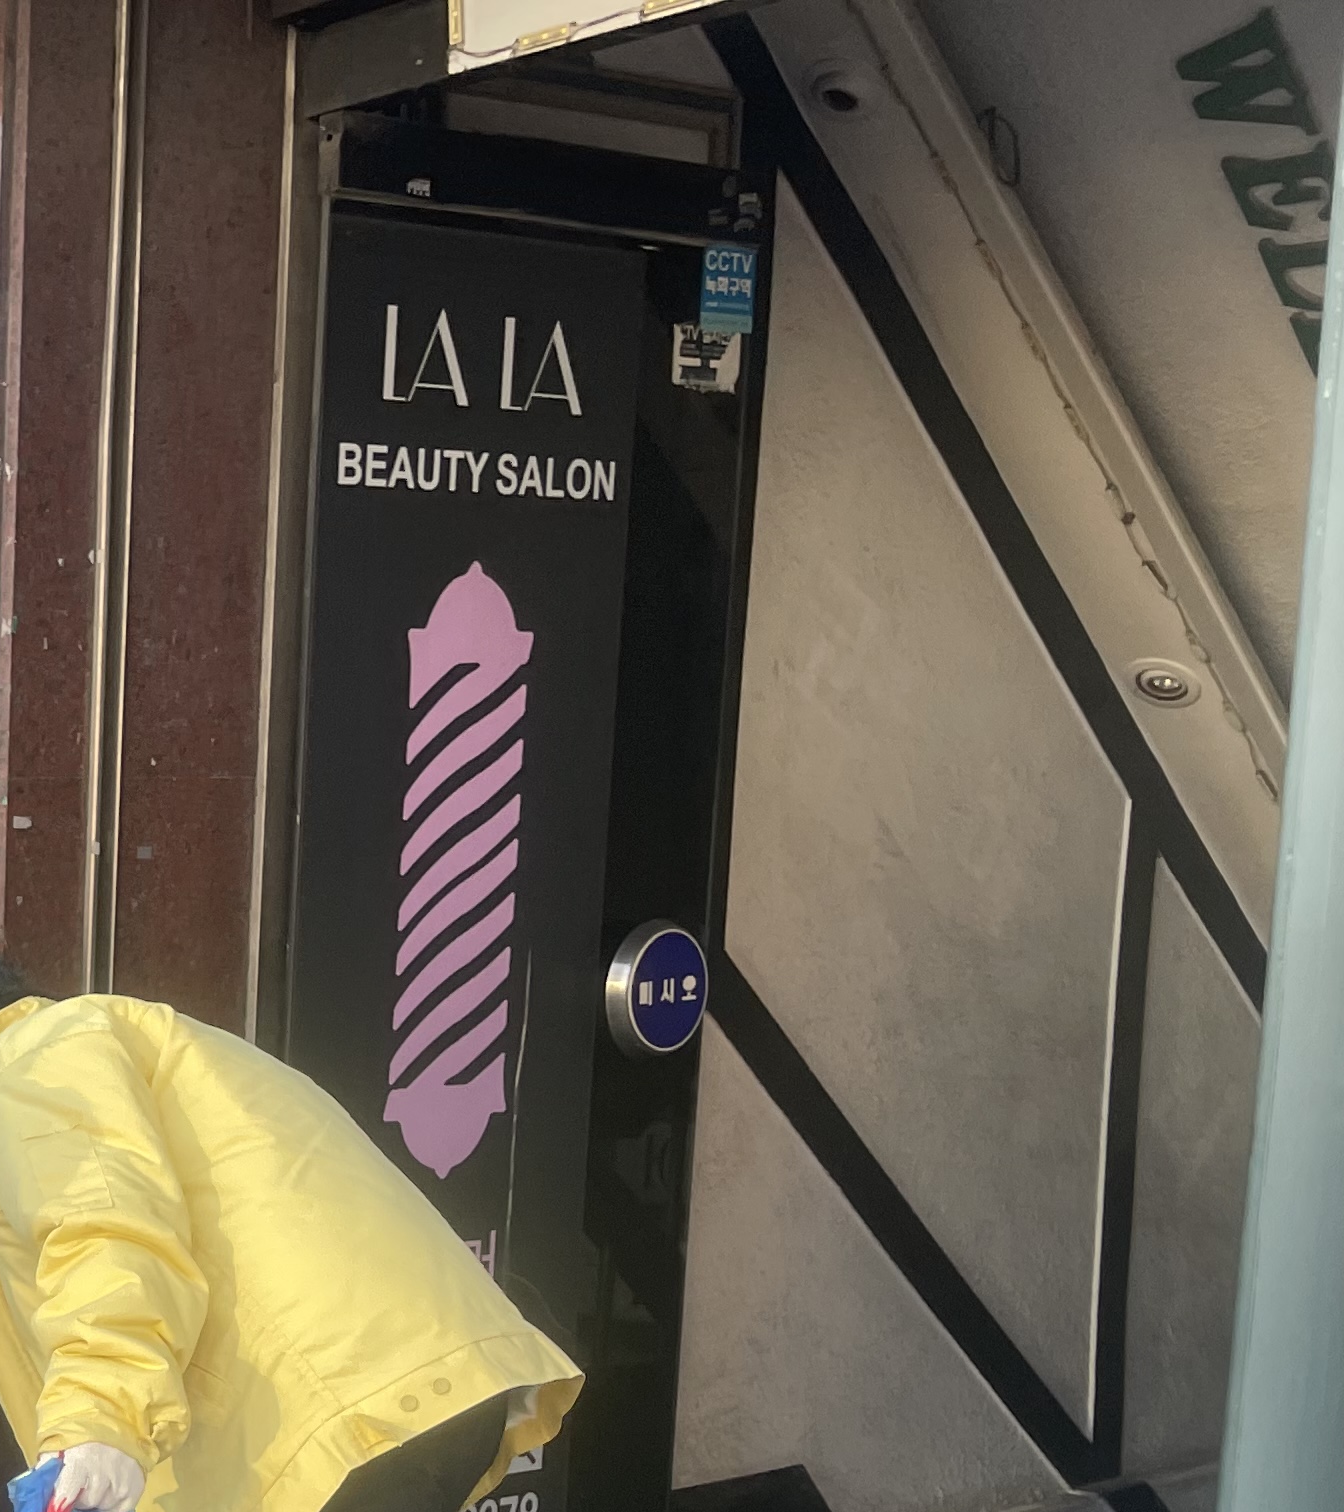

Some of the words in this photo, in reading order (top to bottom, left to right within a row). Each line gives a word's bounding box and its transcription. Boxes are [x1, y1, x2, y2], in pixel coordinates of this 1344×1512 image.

[705, 251, 753, 274] CCTV
[383, 304, 469, 407] LA
[501, 317, 582, 416] LA
[337, 442, 490, 493] BEAUTY
[496, 453, 616, 501] SALON
[639, 975, 698, 1007] 미시오
